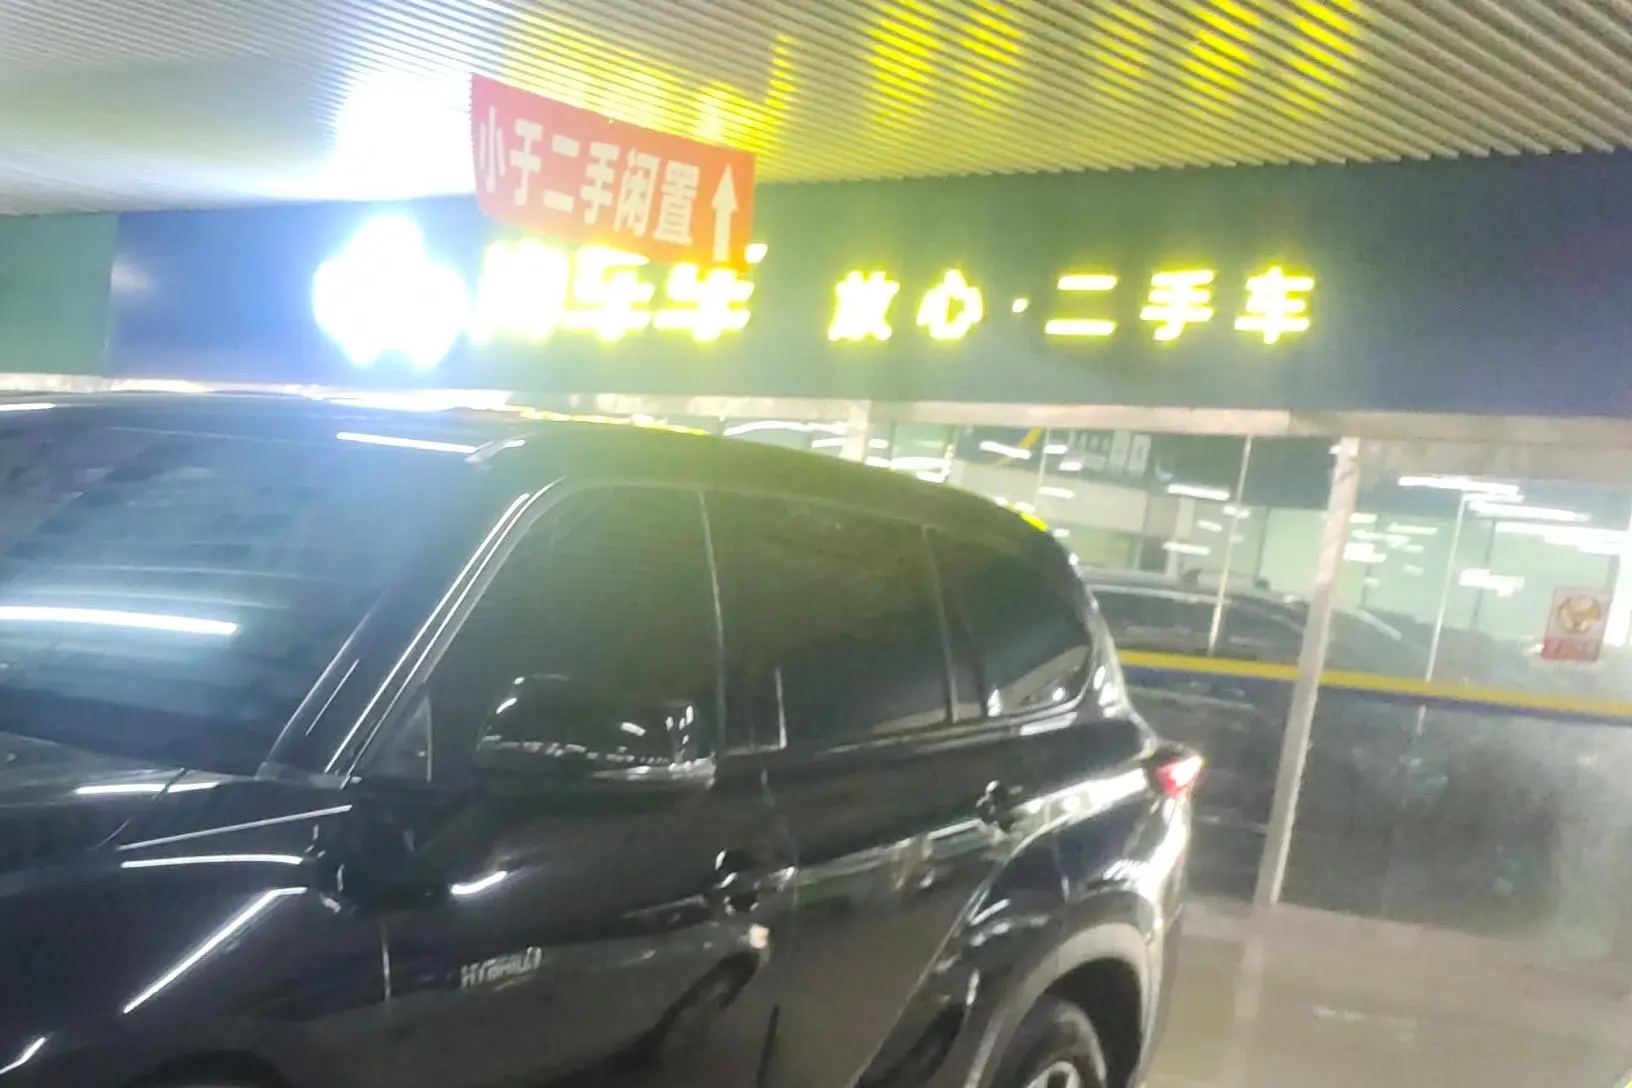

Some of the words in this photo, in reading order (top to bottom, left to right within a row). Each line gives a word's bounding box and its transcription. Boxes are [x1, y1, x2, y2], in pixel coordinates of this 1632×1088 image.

[478, 105, 700, 247] 小于二手闲置
